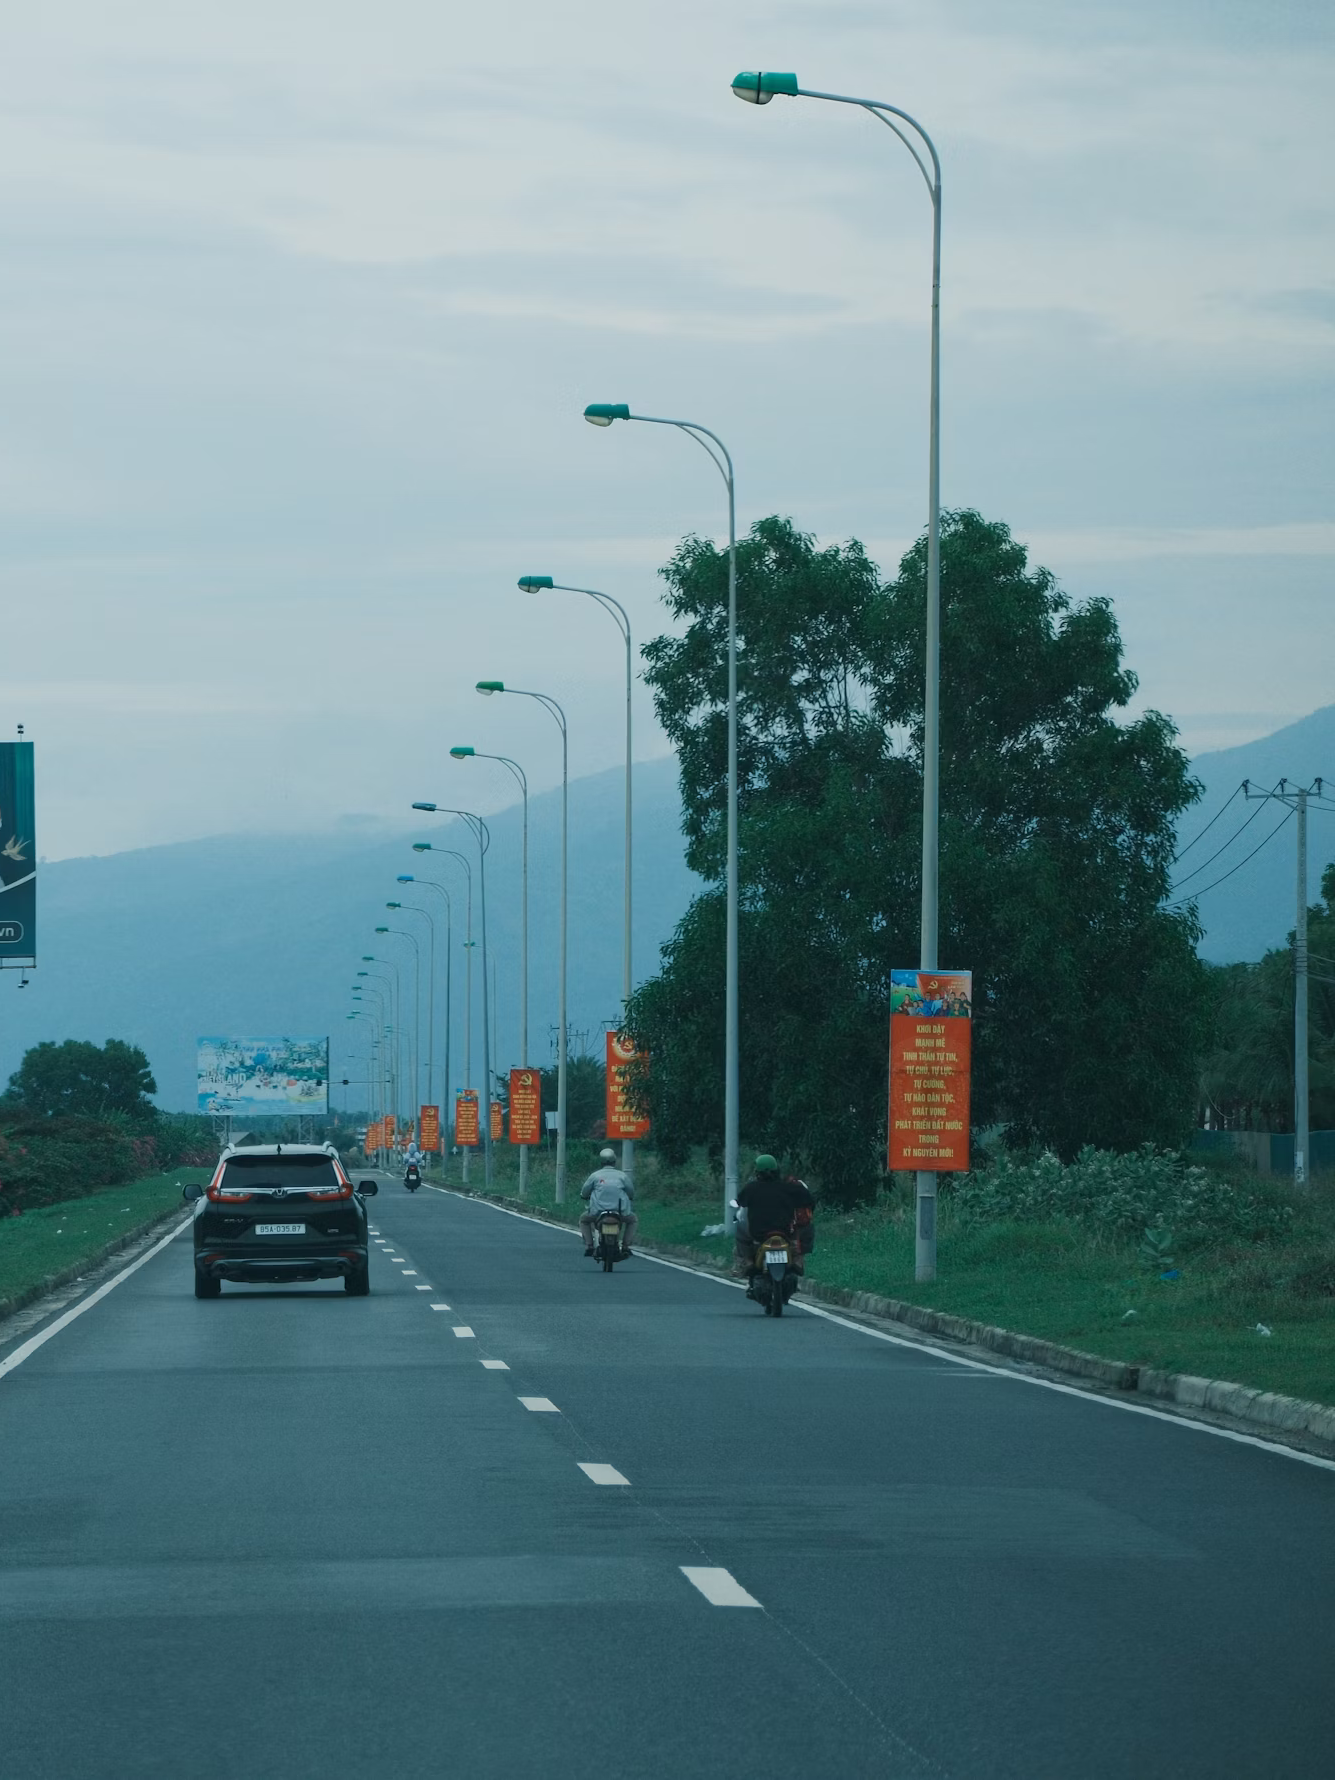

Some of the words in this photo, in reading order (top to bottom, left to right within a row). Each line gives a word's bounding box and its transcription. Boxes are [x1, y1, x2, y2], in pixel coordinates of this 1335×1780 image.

[915, 1038, 934, 1049] MẠNH
[912, 1106, 928, 1116] KHÁT
[929, 1107, 947, 1118] VỌNG
[918, 1134, 939, 1144] TRONG
[912, 1147, 938, 1158] NGUYÊN
